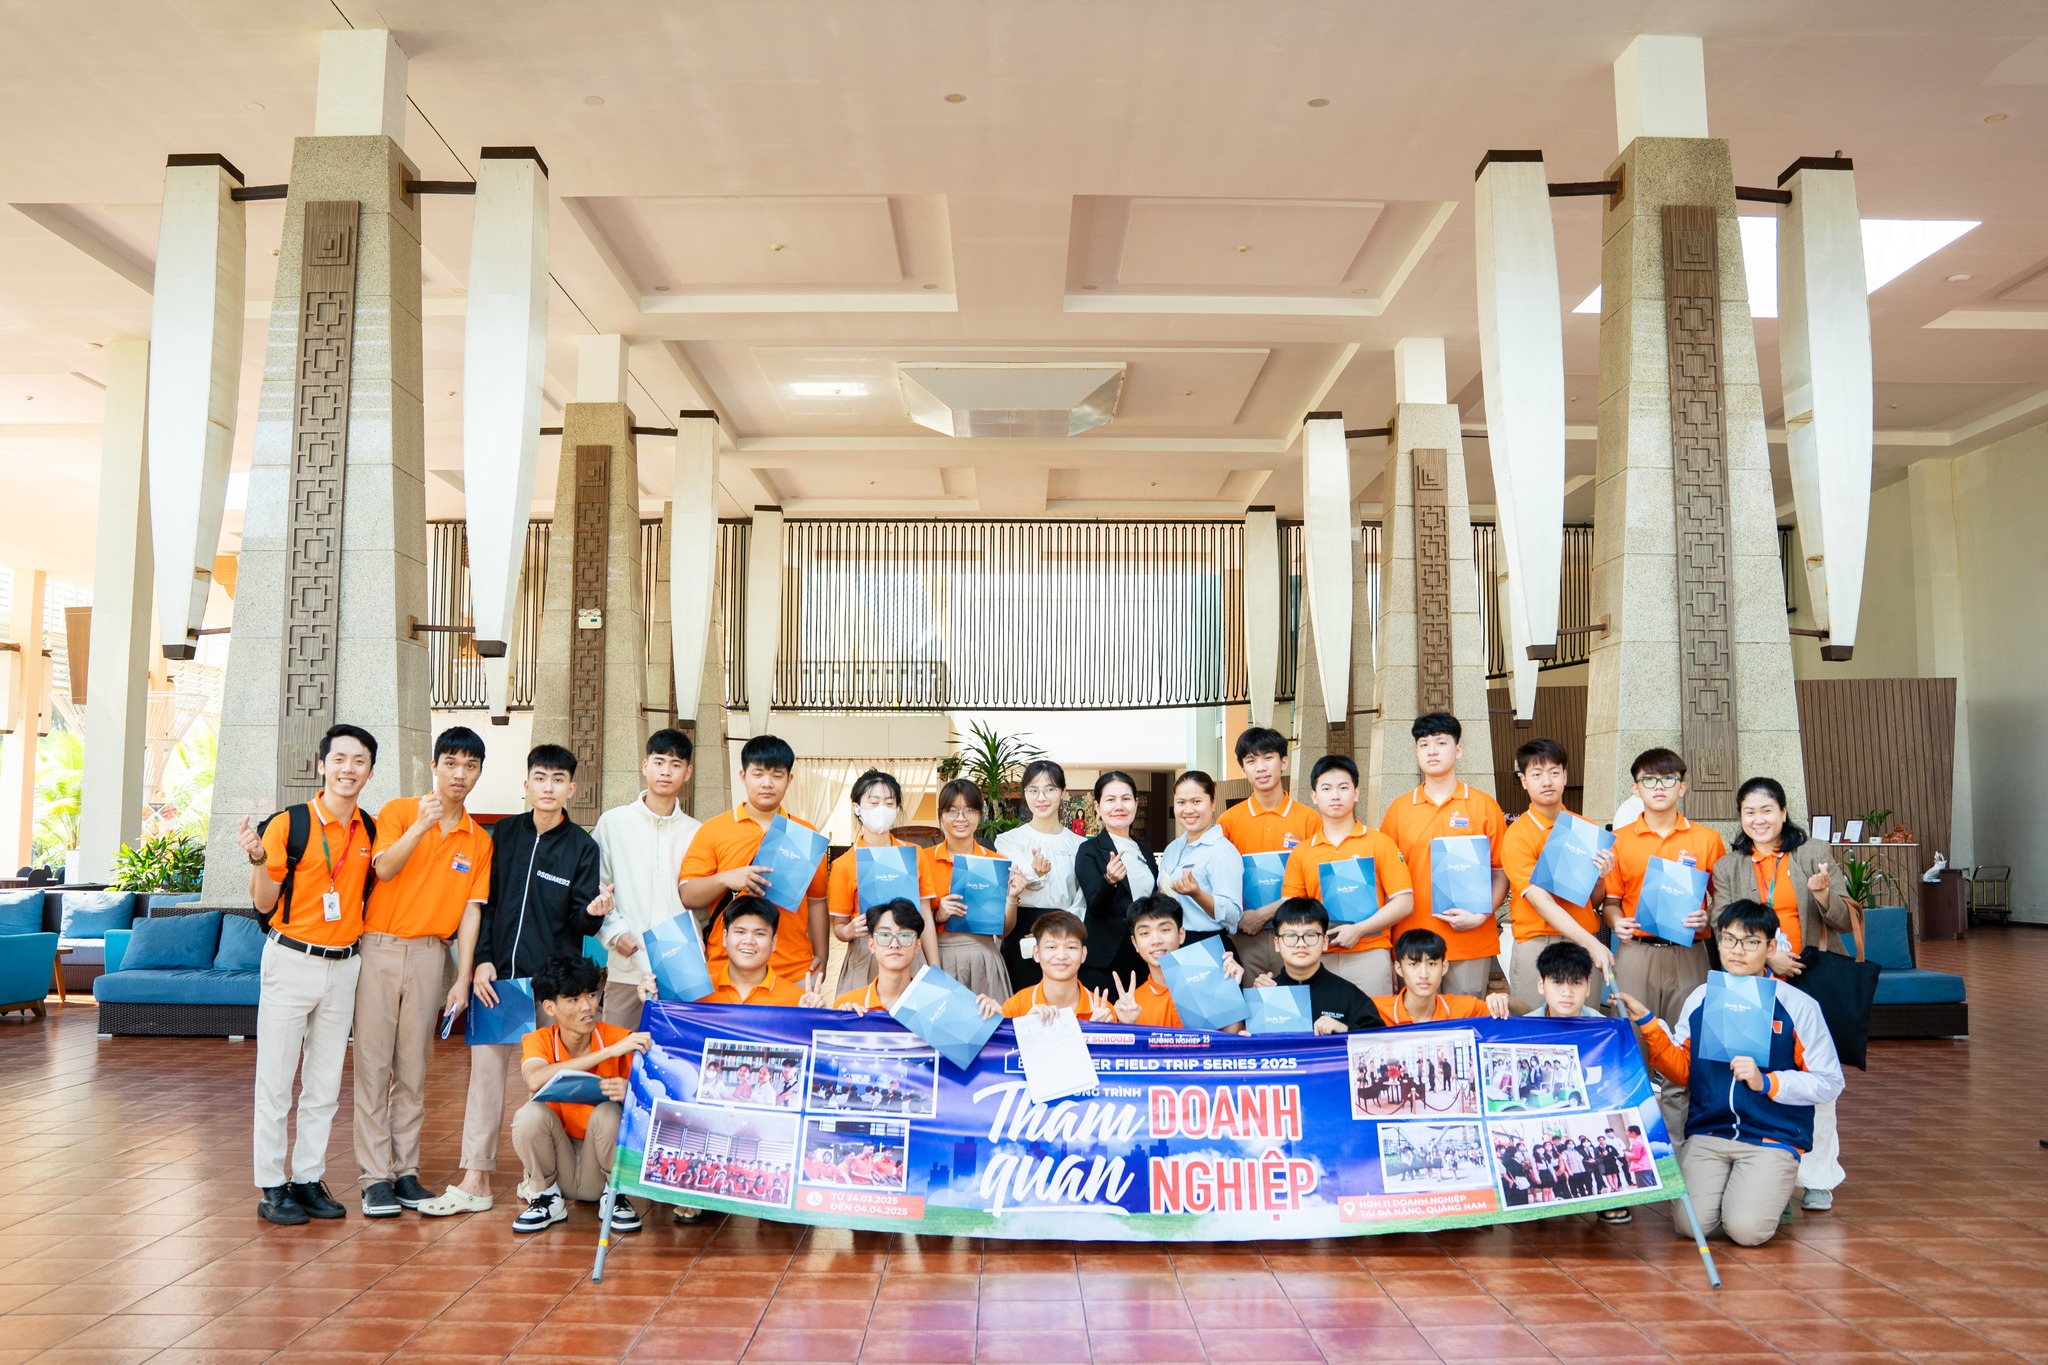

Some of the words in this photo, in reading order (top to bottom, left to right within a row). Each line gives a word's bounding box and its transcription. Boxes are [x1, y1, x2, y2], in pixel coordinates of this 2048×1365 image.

[537, 870, 571, 887] DSQUARED2
[1092, 1035, 1134, 1043] SCHOOLS
[1115, 1058, 1160, 1071] FIELD
[1163, 1058, 1198, 1071] TRIP
[1203, 1058, 1257, 1071] SERIES
[1260, 1057, 1298, 1070] 2025
[1102, 1085, 1142, 1098] TRÌNH
[973, 1081, 1145, 1143] Tham
[1149, 1086, 1302, 1140] DOANH
[980, 1154, 1135, 1218] quan
[1151, 1149, 1316, 1221] NGHIỆP
[847, 1194, 898, 1205] 24.03.2025
[1392, 1197, 1428, 1207] DOANH
[854, 1204, 908, 1216] 04.04.2025
[1463, 1202, 1487, 1210] NAM
